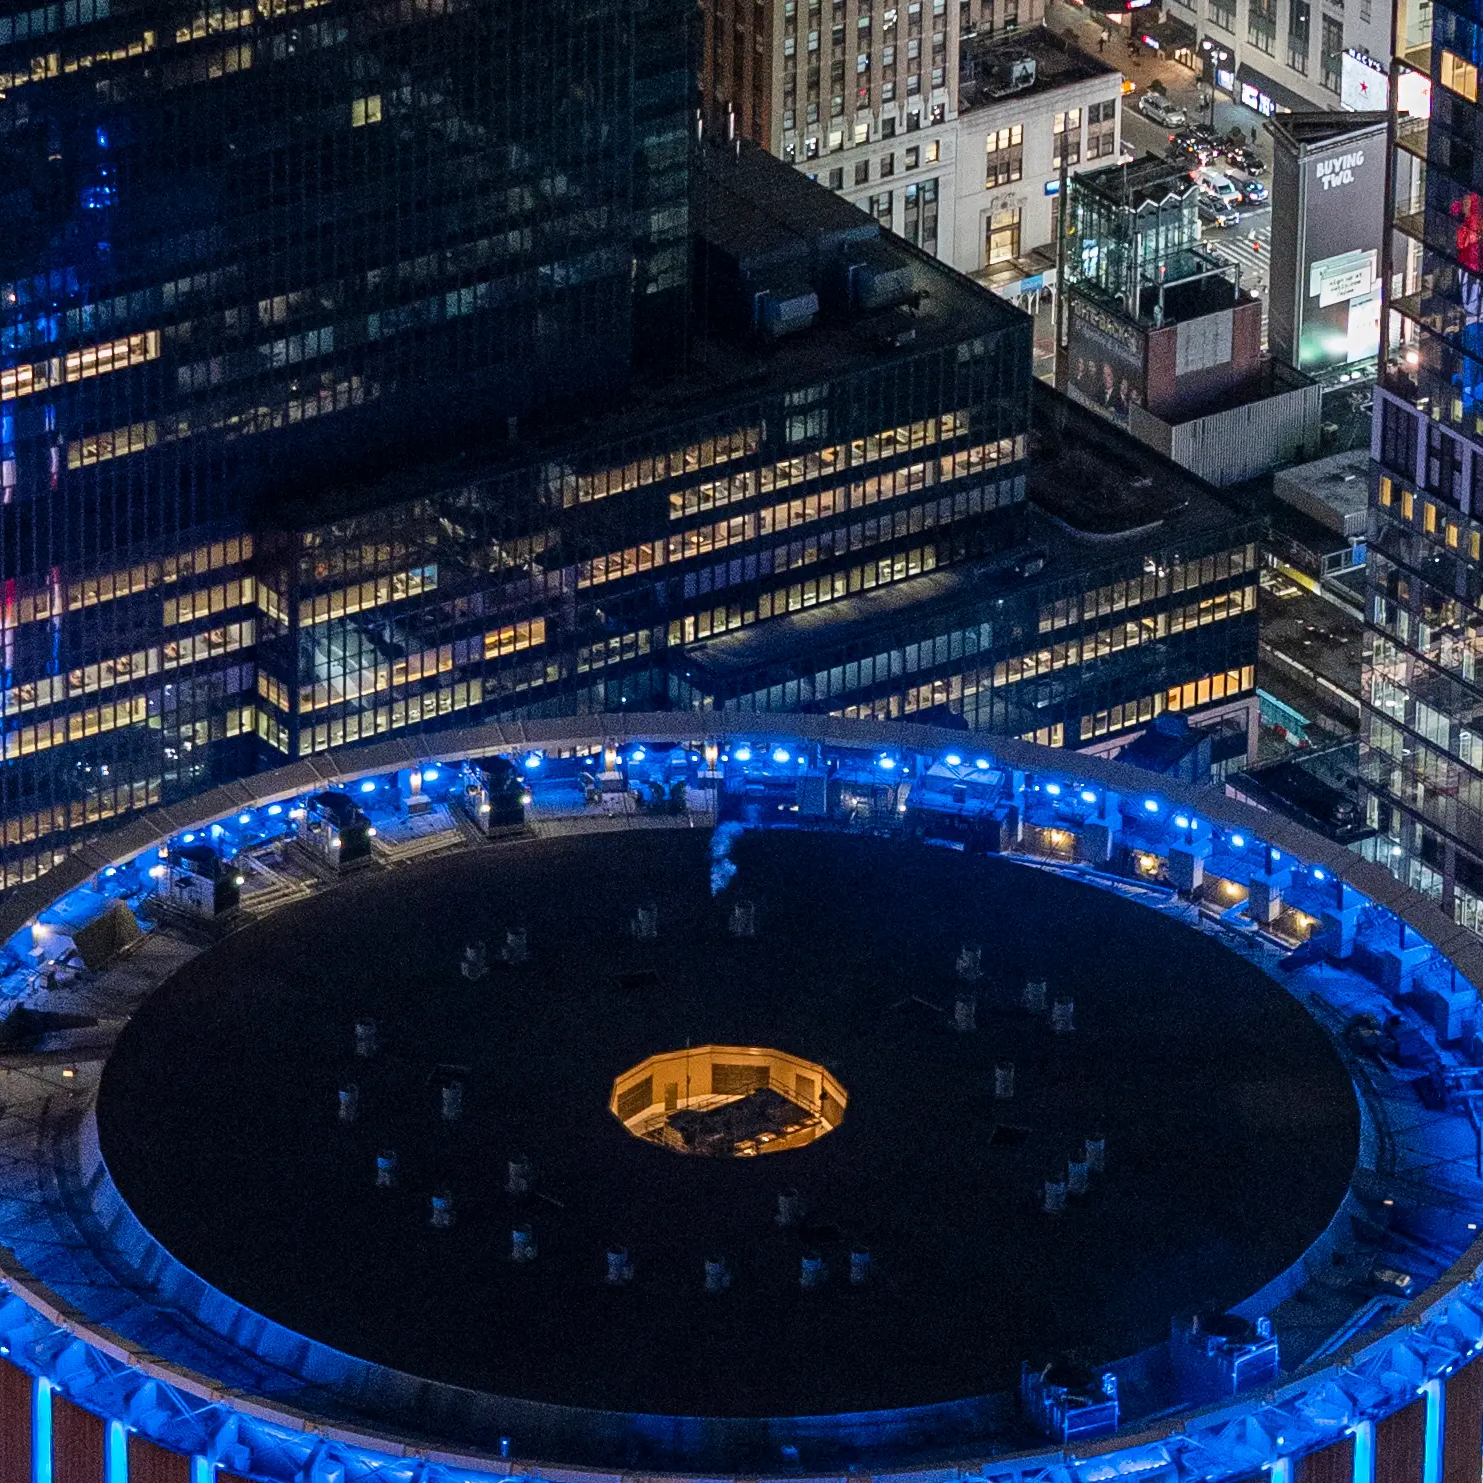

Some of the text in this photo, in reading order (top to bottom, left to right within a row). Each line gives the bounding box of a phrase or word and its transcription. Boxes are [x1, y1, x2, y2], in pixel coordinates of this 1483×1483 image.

[1349, 49, 1381, 72] MACY'S
[1317, 151, 1365, 178] BUYING
[1322, 170, 1354, 190] TWO.
